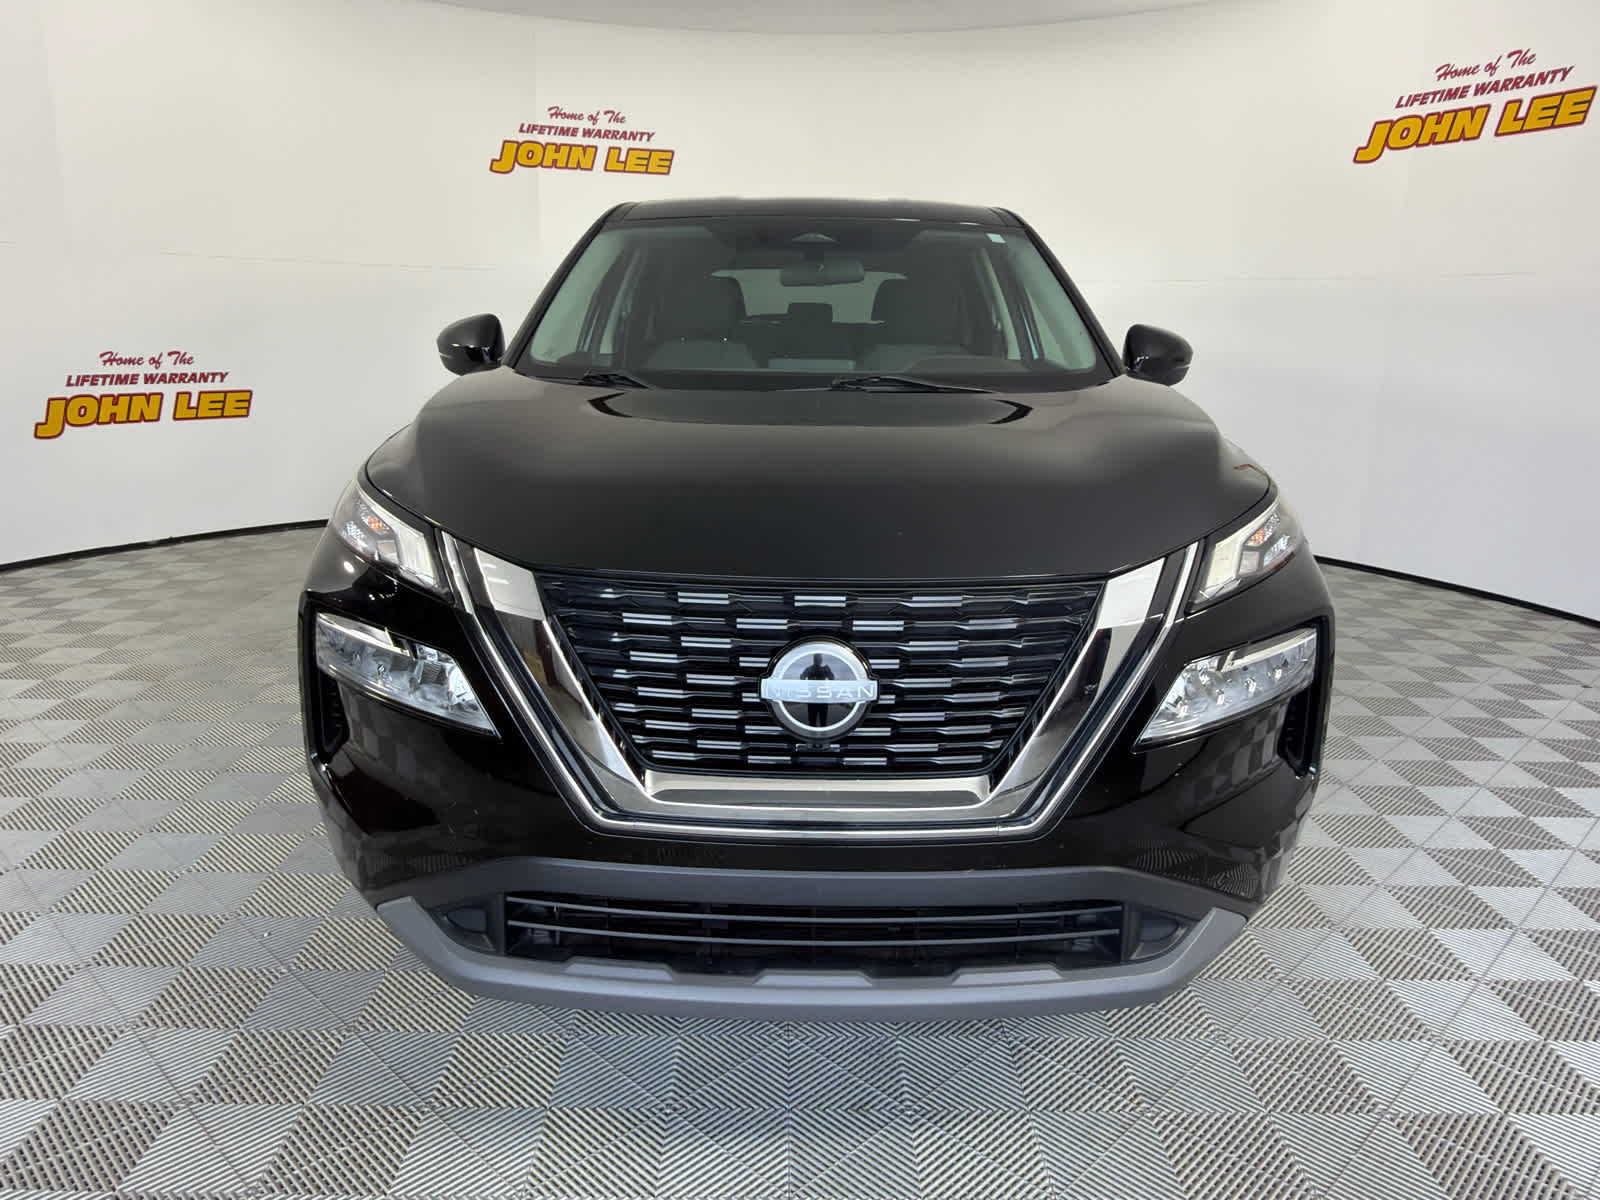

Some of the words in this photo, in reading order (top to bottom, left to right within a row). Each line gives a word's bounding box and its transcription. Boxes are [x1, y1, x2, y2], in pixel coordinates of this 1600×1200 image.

[1435, 63, 1480, 81] Home
[1484, 55, 1502, 76] of
[1506, 48, 1536, 68] The
[1395, 84, 1471, 108] LIFETIME
[1473, 65, 1575, 97] WARRANTY
[548, 106, 584, 121] Home
[588, 111, 600, 125] of
[603, 110, 626, 124] The
[1353, 103, 1491, 164] JOHN
[1494, 85, 1598, 137] LEE
[518, 123, 579, 137] LIFETIME
[582, 129, 656, 142] WARRANTY
[489, 140, 598, 174] JOHN
[604, 146, 675, 175] LEE
[99, 351, 144, 366] Home
[149, 353, 163, 369] of
[167, 350, 194, 366] The
[65, 373, 140, 387] LIFETIME
[143, 371, 229, 384] WARRANTY
[34, 391, 164, 439] JOHN
[172, 389, 253, 421] LEE
[765, 685, 874, 698] NISSAN
